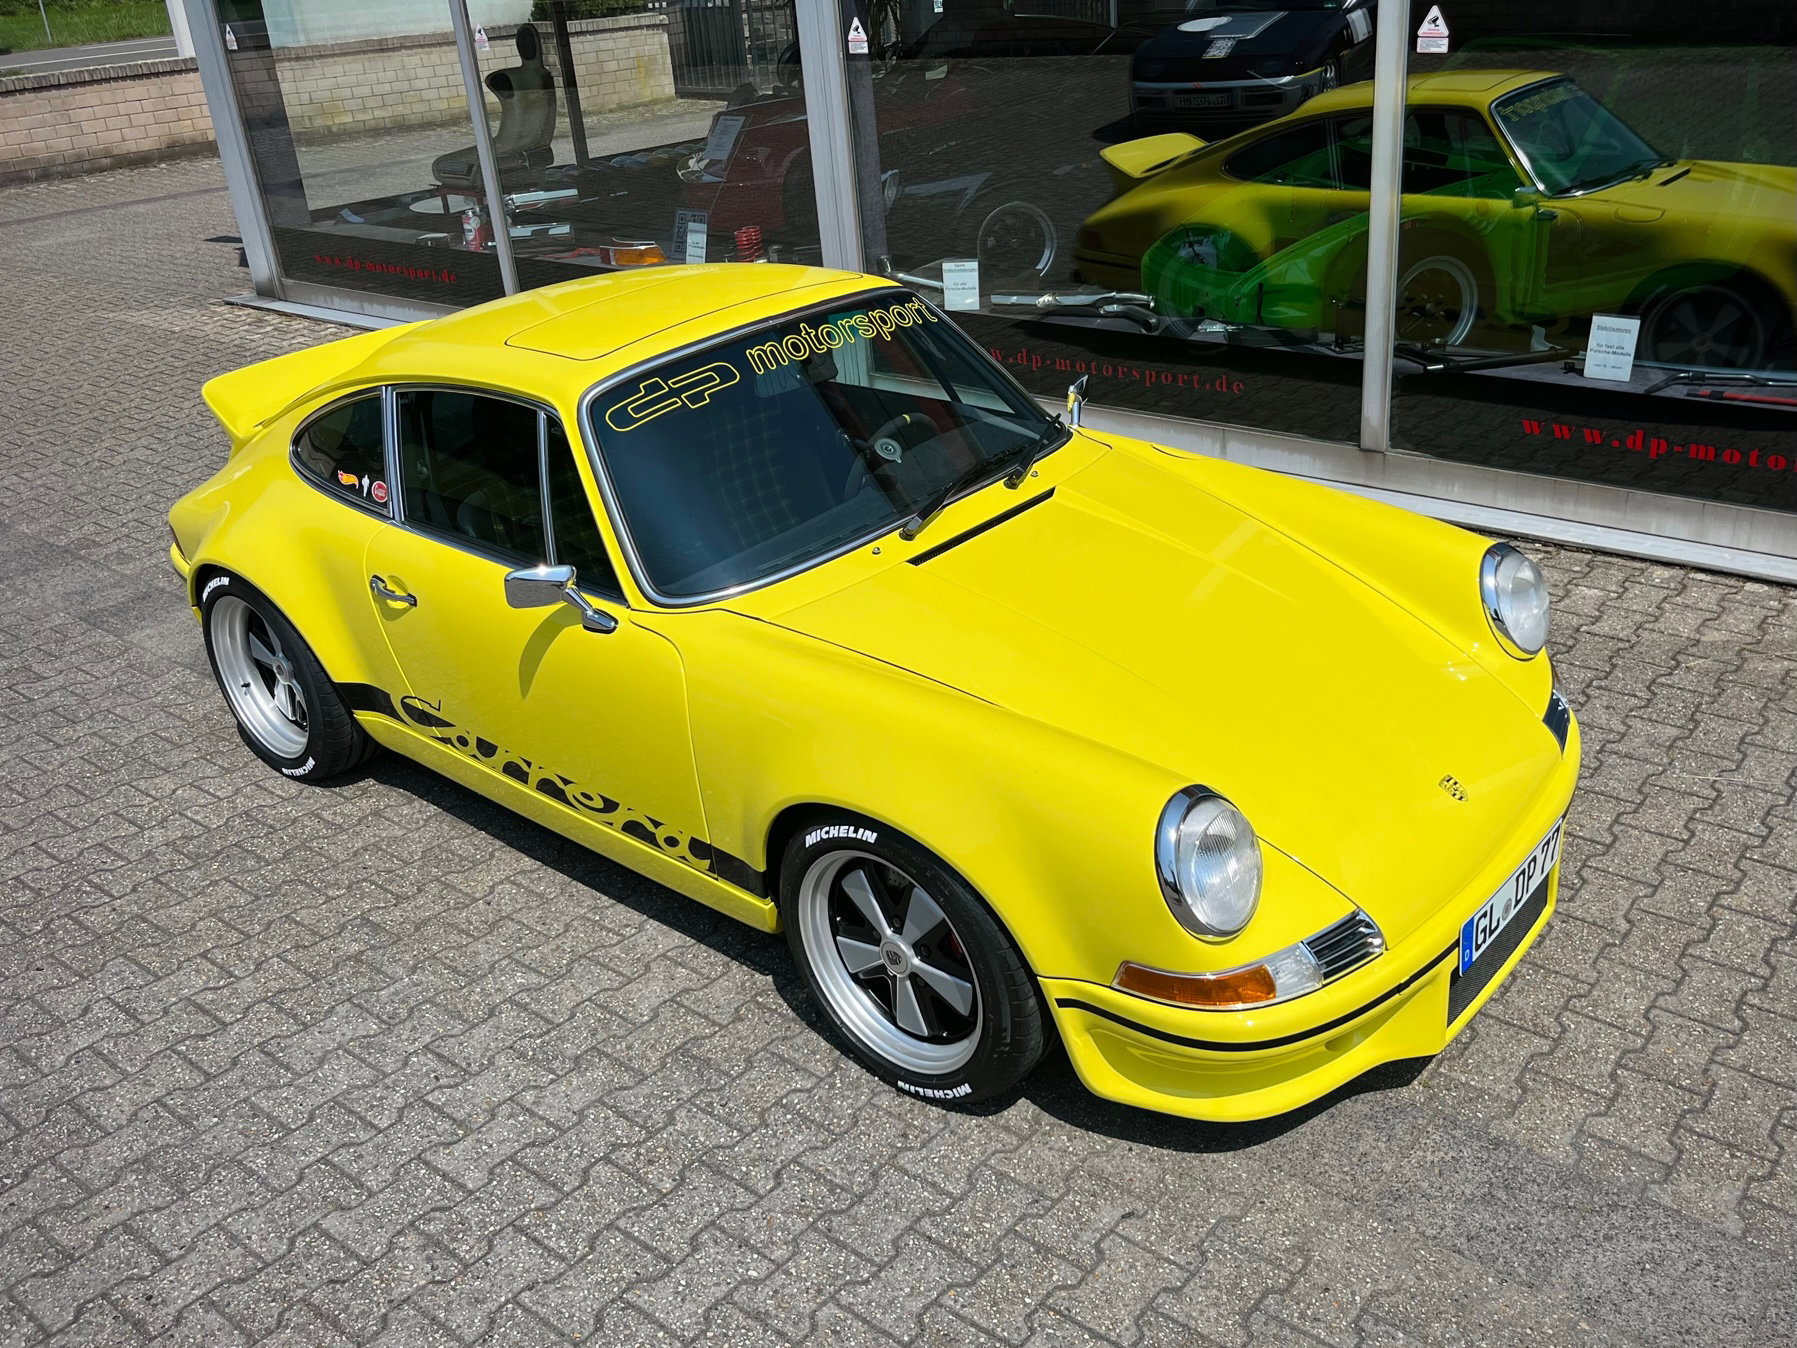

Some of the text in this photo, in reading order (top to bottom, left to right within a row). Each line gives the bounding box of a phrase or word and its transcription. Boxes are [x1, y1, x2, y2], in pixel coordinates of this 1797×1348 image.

[746, 297, 938, 375] motorsport
[990, 348, 1246, 395] w.dp-motorsport.de
[390, 693, 713, 874] Carrera
[805, 825, 877, 848] MICHELIN
[1474, 823, 1561, 953] GL DP 77
[897, 1080, 973, 1099] MICHELIN
